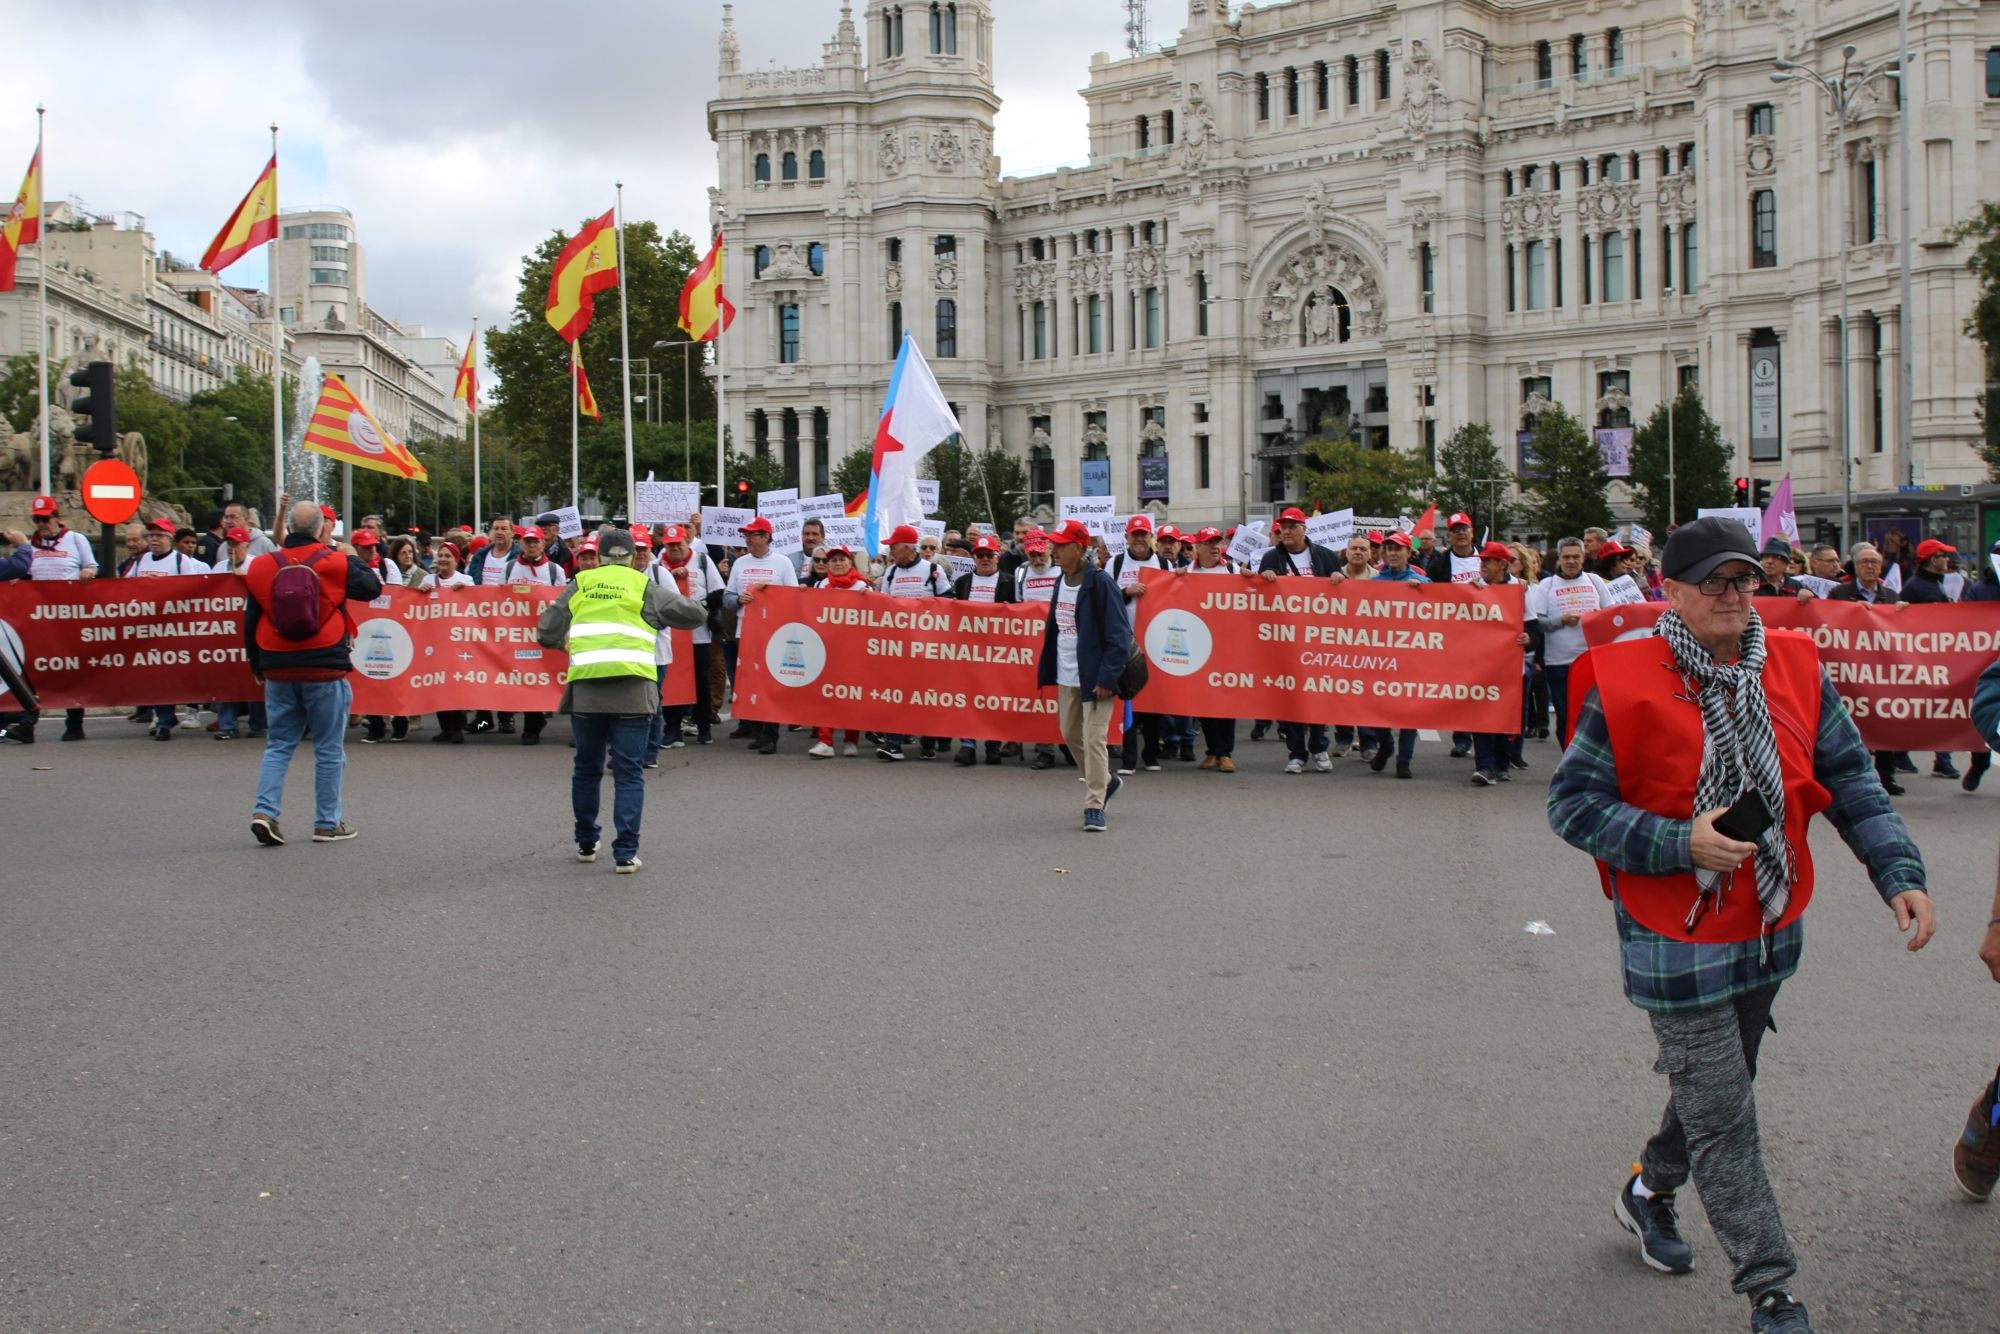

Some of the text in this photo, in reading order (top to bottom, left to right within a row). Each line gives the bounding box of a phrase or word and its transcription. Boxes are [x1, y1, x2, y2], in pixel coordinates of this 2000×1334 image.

[30, 599, 156, 620] JUBILACIÓN
[403, 597, 530, 621] JUBILACIÓN
[1199, 591, 1503, 622] JUBILACIÓN ANTICIPADA
[81, 620, 237, 642] SIN PENALIZAR
[816, 606, 950, 632] JUBILACIÓN
[450, 626, 487, 642] SIN
[1258, 623, 1444, 650] SIN PENALIZAR
[34, 656, 80, 672] CON
[88, 653, 125, 667] +40
[132, 649, 191, 666] AÑOS
[867, 638, 1034, 666] SIN PENALIZAR
[1300, 651, 1398, 671] CATALUNYA
[410, 671, 445, 689] CON
[453, 671, 487, 684] +40
[494, 669, 550, 686] AÑOS
[1208, 671, 1501, 701] CON +40 AÑOS COTIZADOS
[821, 683, 862, 701] CON
[869, 687, 903, 704] +40
[910, 689, 967, 709] AÑOS
